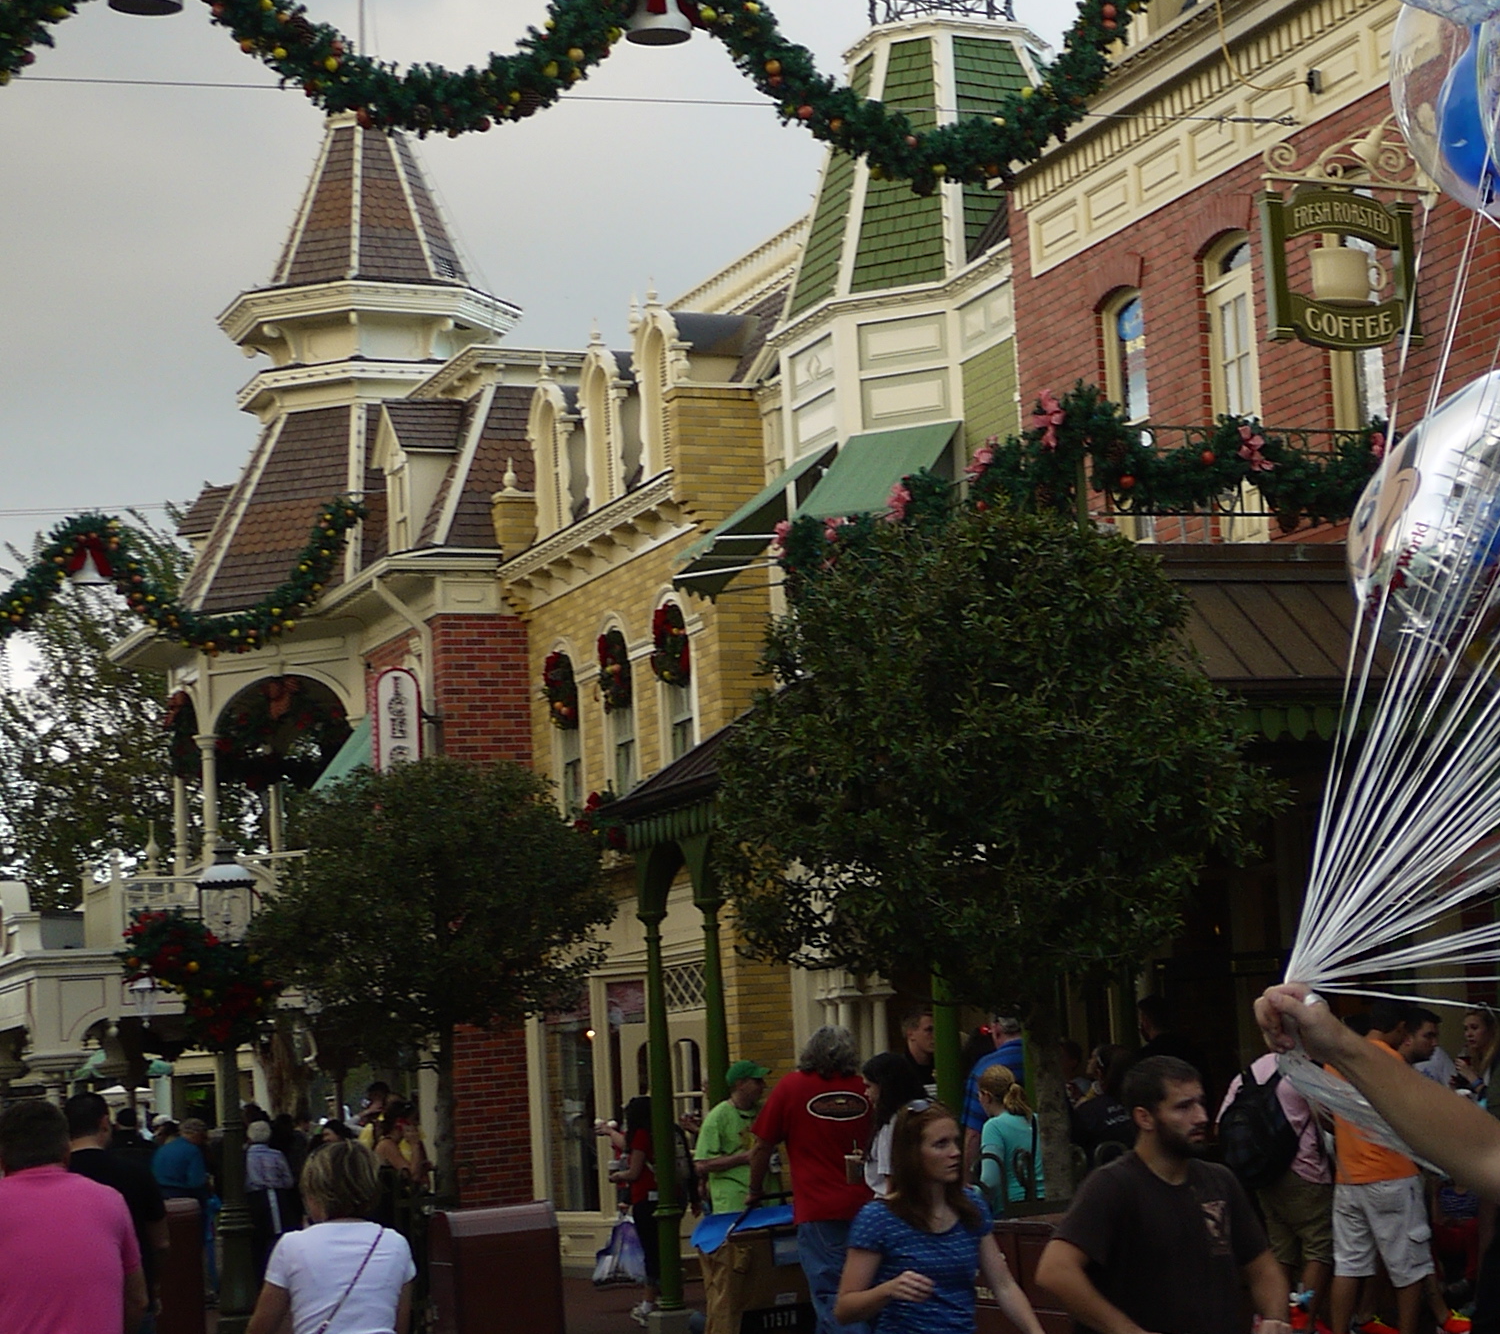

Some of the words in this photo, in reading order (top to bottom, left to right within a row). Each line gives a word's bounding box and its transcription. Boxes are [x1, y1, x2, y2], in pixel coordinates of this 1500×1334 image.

[1293, 201, 1332, 230] FRESH
[1333, 201, 1391, 236] ROASTED
[1304, 307, 1395, 341] COFFEE
